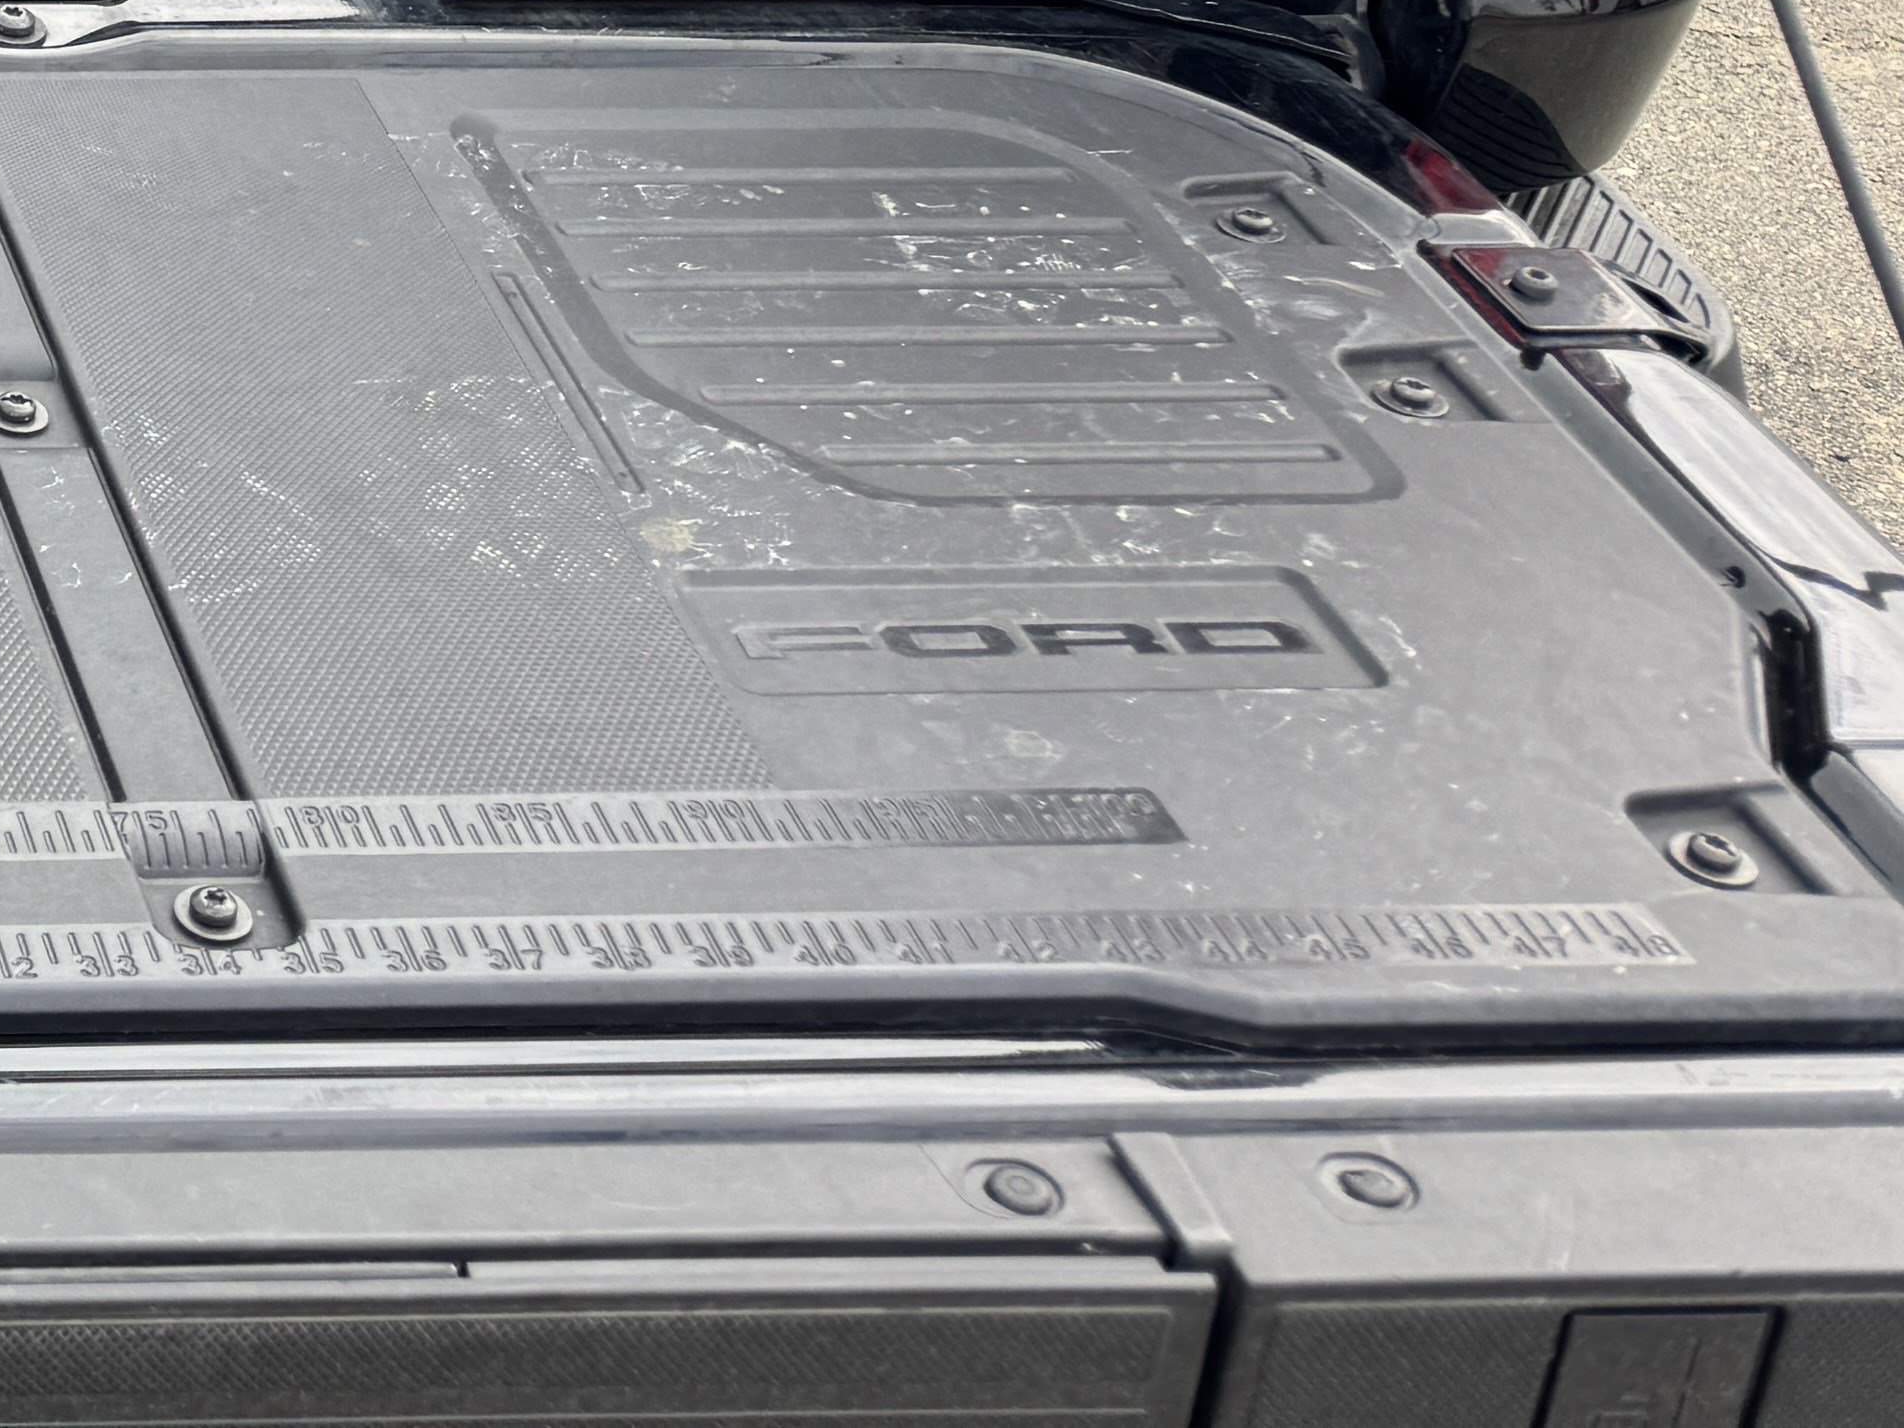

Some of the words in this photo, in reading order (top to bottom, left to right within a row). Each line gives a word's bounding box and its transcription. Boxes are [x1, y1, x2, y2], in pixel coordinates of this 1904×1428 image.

[733, 620, 1326, 659] FORD
[110, 810, 168, 832] 75
[302, 805, 360, 826] 80
[492, 802, 553, 823] 85
[78, 954, 140, 978] 33
[178, 953, 243, 976] 34
[281, 952, 345, 975] 35
[386, 951, 448, 974] 36
[487, 947, 545, 971] 37
[591, 946, 653, 970] 38
[691, 945, 756, 968] 39
[792, 943, 857, 966] 40
[1509, 935, 1568, 958] 47
